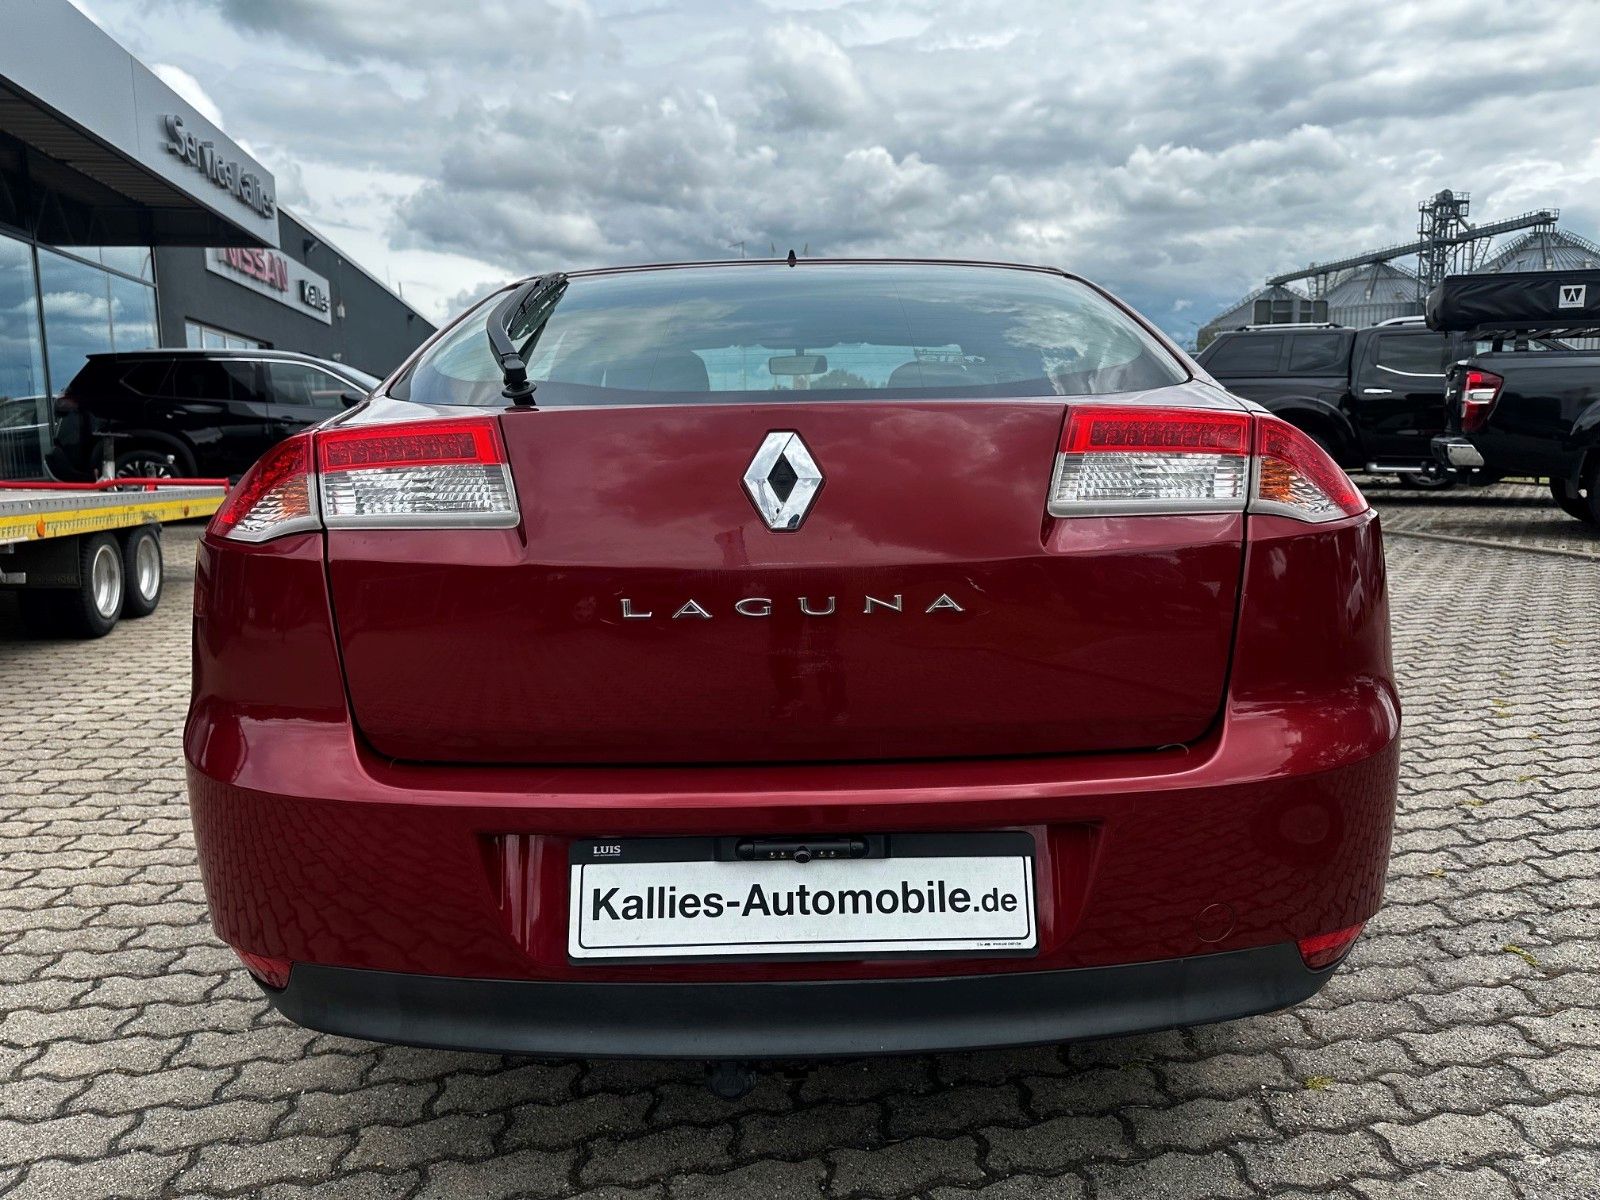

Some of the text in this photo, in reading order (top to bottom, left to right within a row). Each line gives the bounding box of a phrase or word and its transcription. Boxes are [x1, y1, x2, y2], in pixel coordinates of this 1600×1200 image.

[165, 115, 232, 189] Service
[620, 593, 966, 619] LAGUNA
[593, 845, 621, 854] LUIS
[592, 880, 1018, 921] Kallies-Automobile.de
